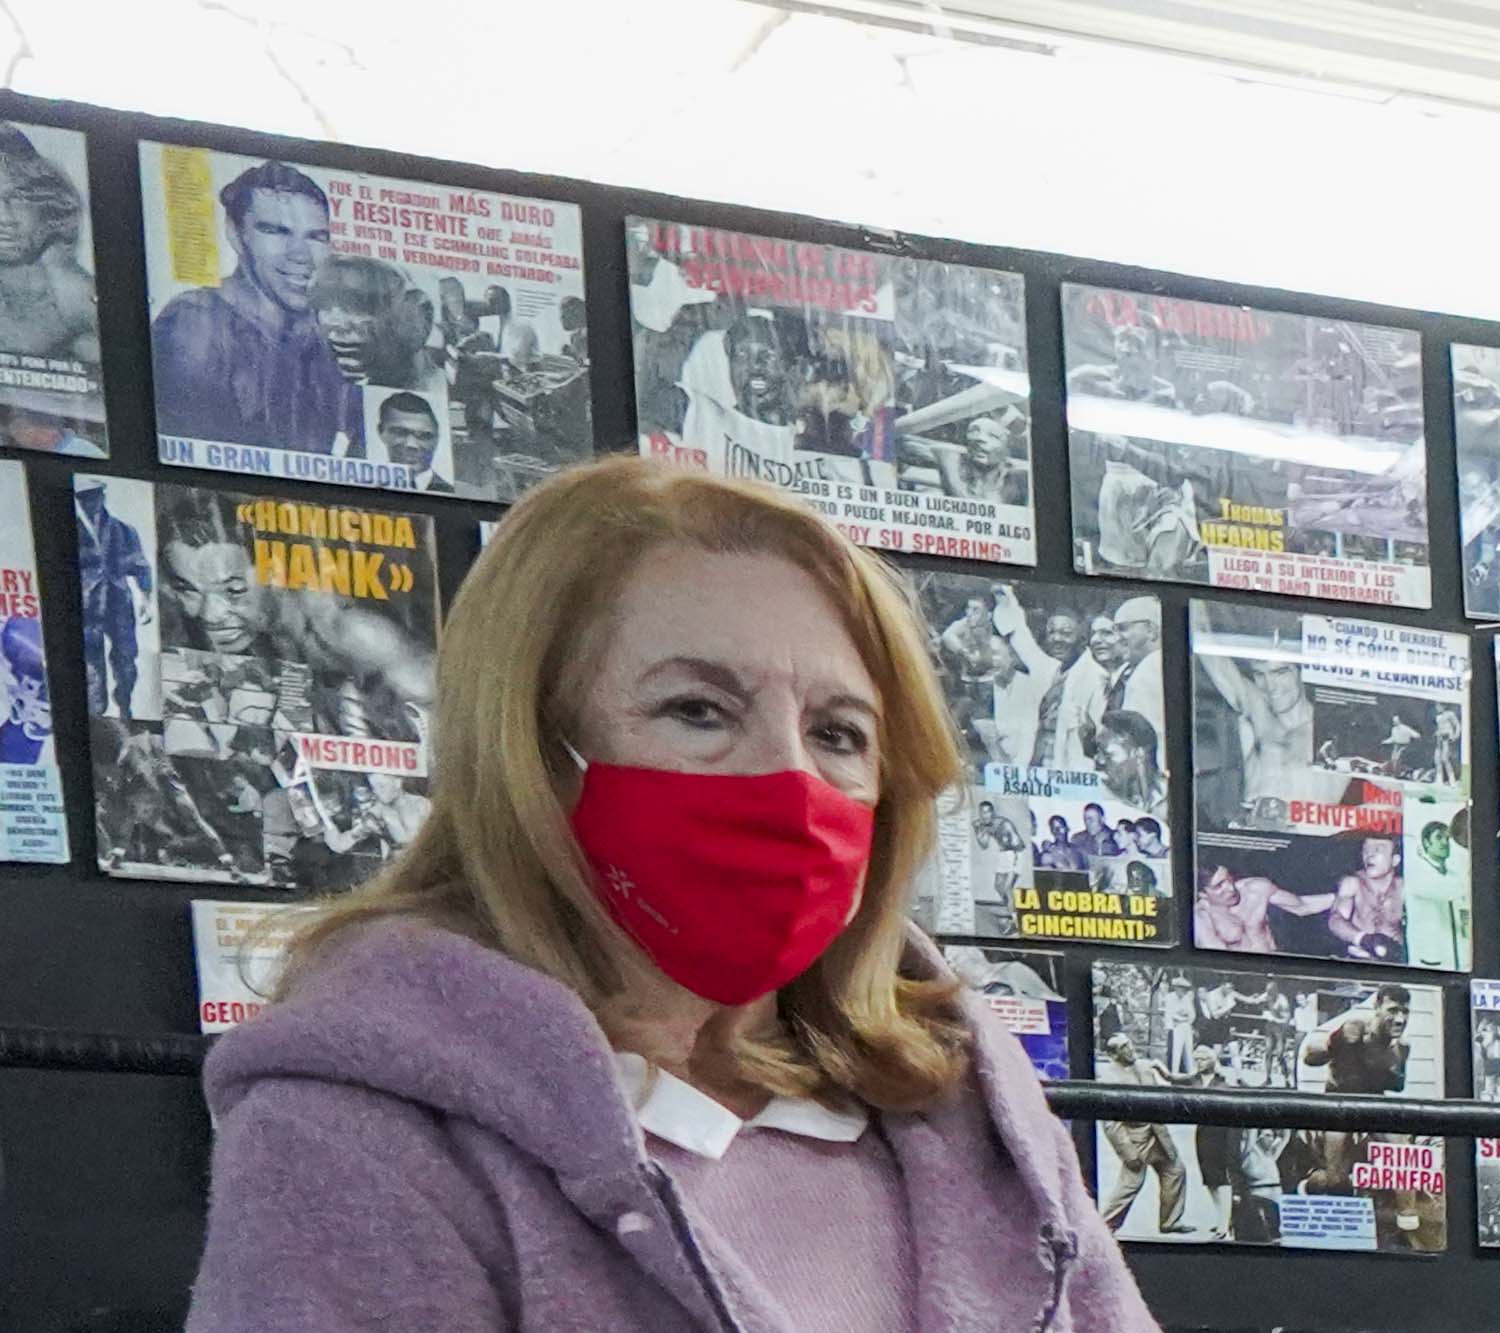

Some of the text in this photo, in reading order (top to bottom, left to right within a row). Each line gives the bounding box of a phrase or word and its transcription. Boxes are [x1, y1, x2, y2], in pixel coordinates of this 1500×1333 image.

[353, 201, 468, 237] RESISTENTE
[449, 191, 554, 227] MÁS DURO
[160, 437, 271, 472] UN GRAN
[837, 484, 997, 519] ES UN BUEN LUCHADOR
[1220, 498, 1284, 528] THOMAS
[237, 501, 415, 550] «HOMICIDA
[844, 505, 1031, 541] PUEDE POR ALGO
[880, 528, 904, 548] SU
[1201, 522, 1285, 552] HEARNS
[254, 540, 414, 600] HANK»
[1300, 564, 1358, 585] INTERIOR
[1046, 769, 1099, 787] PRIMER
[1015, 888, 1157, 917] LA COBRA DE
[1021, 914, 1157, 939] CINCINNATI»
[1473, 994, 1488, 1009] LA
[1370, 1143, 1434, 1170] PRIMO
[1355, 1163, 1444, 1194] CARNERA
